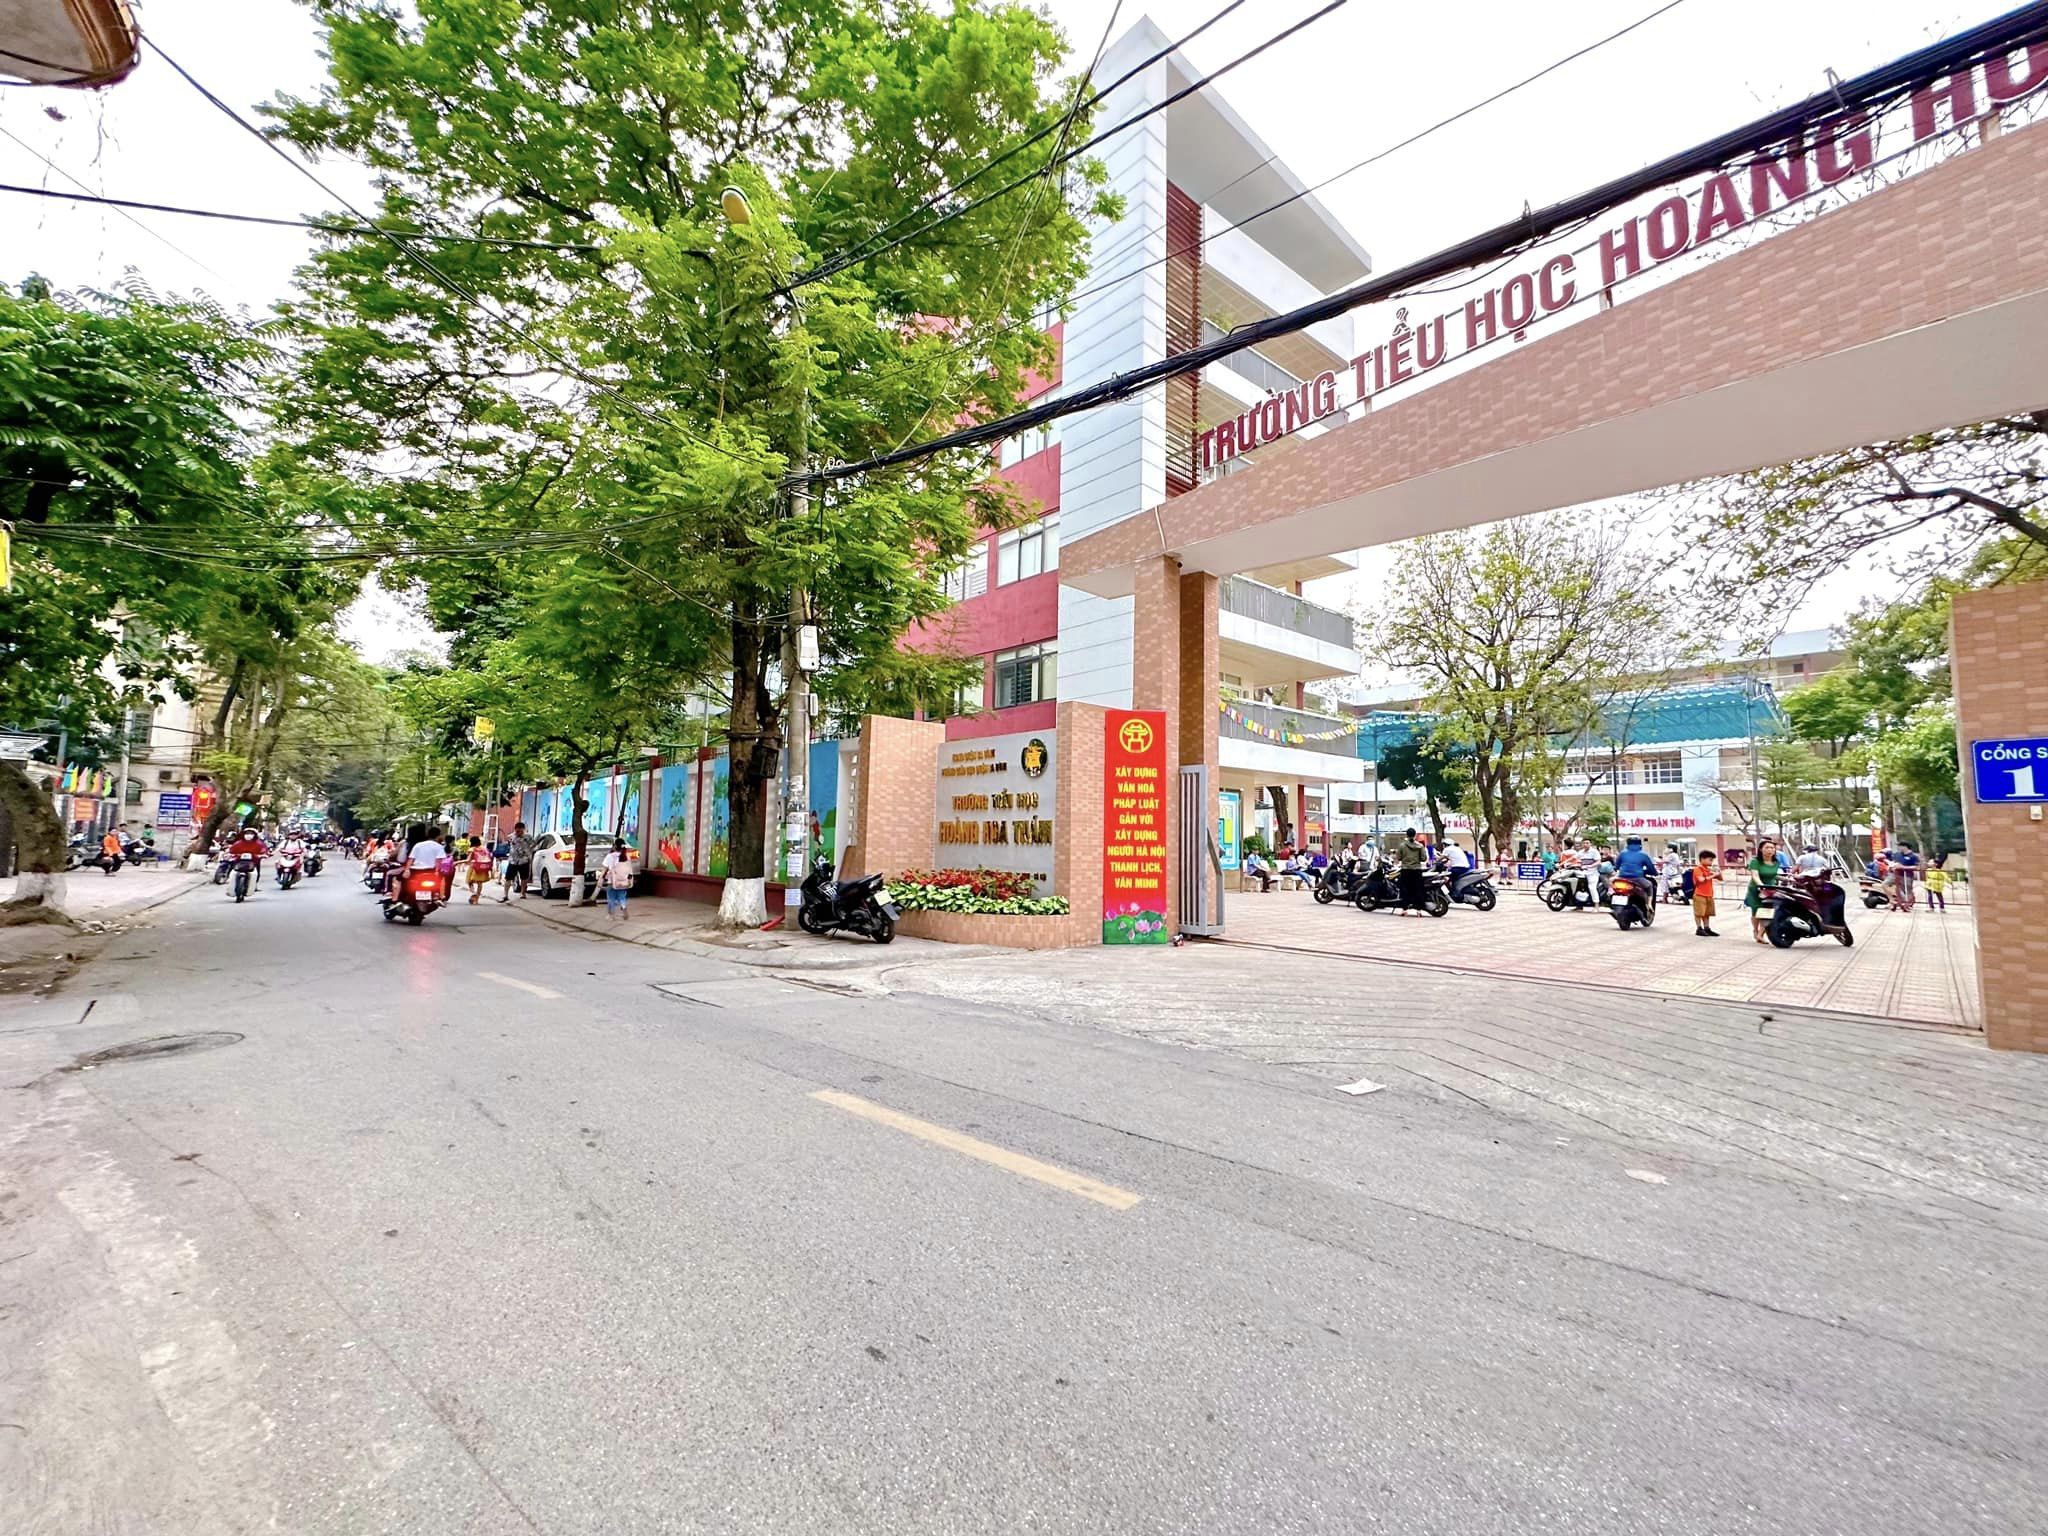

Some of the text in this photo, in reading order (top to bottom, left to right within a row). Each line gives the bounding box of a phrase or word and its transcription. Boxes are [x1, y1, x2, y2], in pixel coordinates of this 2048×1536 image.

[1199, 371, 1337, 470] TRƯỜNG
[1350, 307, 1446, 400] TIỂU
[1464, 254, 1577, 343] HỌC
[1981, 743, 2031, 760] CỔNG
[1115, 766, 1158, 779] XÂY DỰNG
[1117, 781, 1136, 793] VĂN
[2002, 765, 2044, 797] 1
[1113, 796, 1137, 809] PHÁP
[1139, 811, 1154, 824] VỚI
[1115, 828, 1132, 840] XÂY
[1136, 844, 1149, 857] HÀ
[1150, 844, 1166, 859] NỘI
[1110, 861, 1139, 873] THANH
[1115, 876, 1159, 889] VĂN MINH
